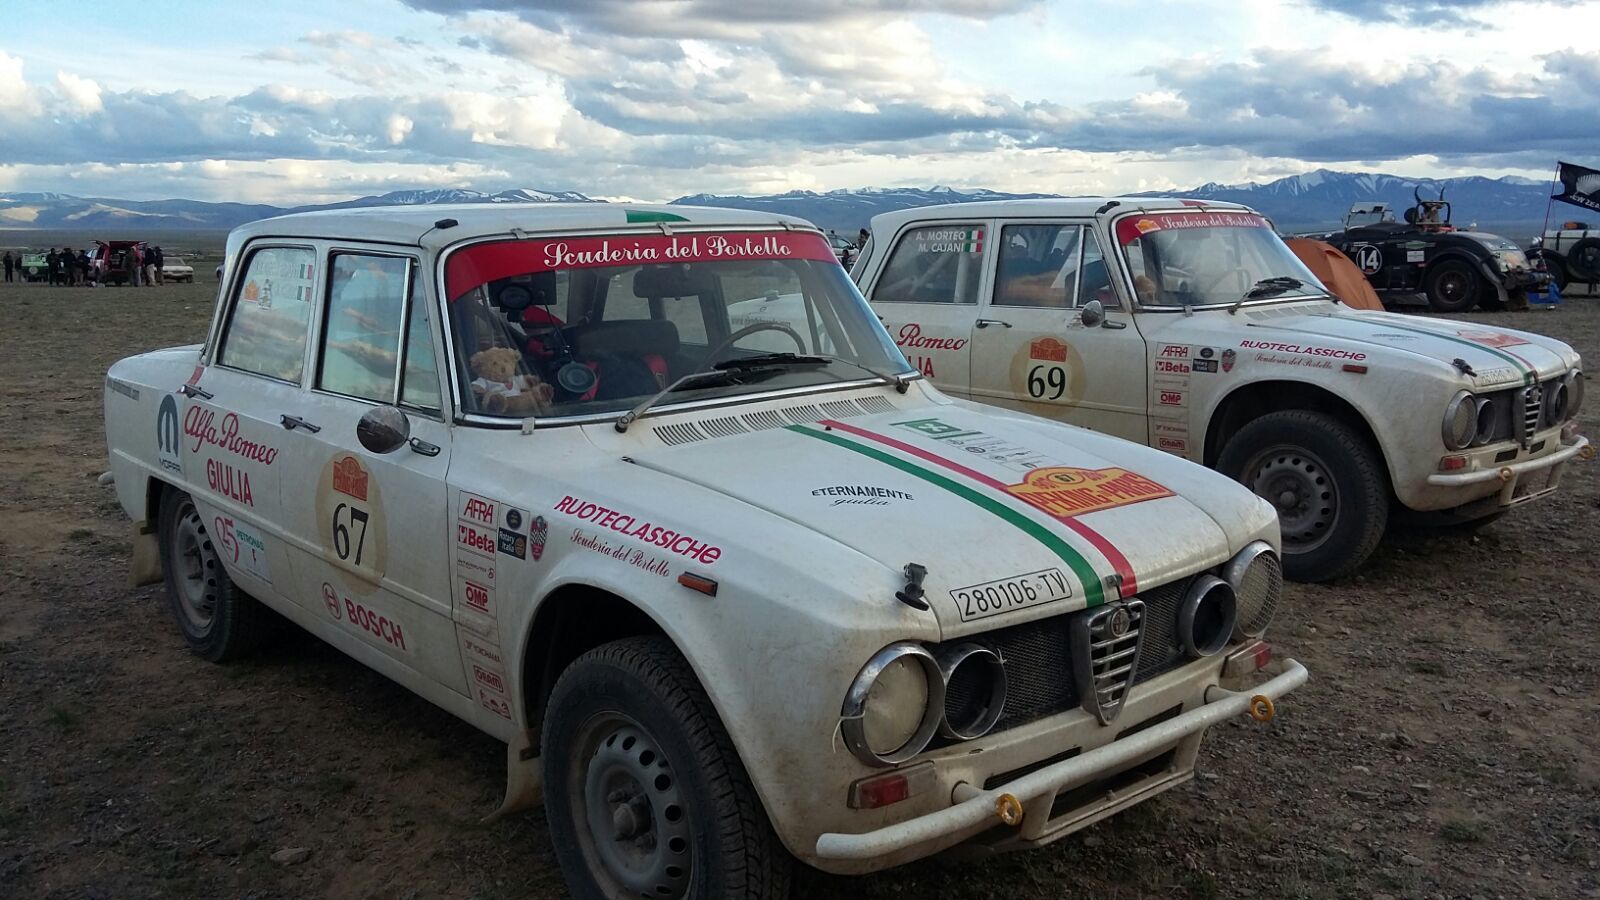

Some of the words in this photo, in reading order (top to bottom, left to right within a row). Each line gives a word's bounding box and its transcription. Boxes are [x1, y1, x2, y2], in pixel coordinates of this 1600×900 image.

[1209, 214, 1225, 226] del
[916, 231, 924, 240] A.
[927, 231, 966, 241] MORTEO
[931, 242, 964, 253] CAJANI
[543, 242, 660, 268] Scuderia
[664, 236, 701, 259] del
[705, 234, 792, 257] Portello
[1361, 250, 1379, 270] 14
[896, 323, 969, 350] Romeo
[1161, 345, 1188, 358] AFRA
[1289, 356, 1302, 367] del
[1165, 361, 1190, 374] Beta
[1028, 365, 1066, 400] 69
[1160, 393, 1182, 404] OMP
[184, 404, 219, 453] Alfa
[219, 412, 279, 466] Romeo
[206, 457, 254, 508] GIULIA
[1054, 473, 1075, 483] 67
[811, 485, 914, 501] ETERNAMENTE
[1018, 487, 1113, 514] PEKING
[1096, 473, 1165, 500] PARIS
[463, 498, 494, 524] AFRA
[332, 503, 369, 567] 67
[468, 528, 495, 554] Beta
[570, 527, 611, 556] Scuderia
[610, 544, 629, 562] del
[631, 549, 669, 577] Portello
[465, 586, 489, 607] OMP
[958, 578, 1037, 616] 280106
[1041, 571, 1068, 597] TV
[345, 598, 406, 651] BOSCH
